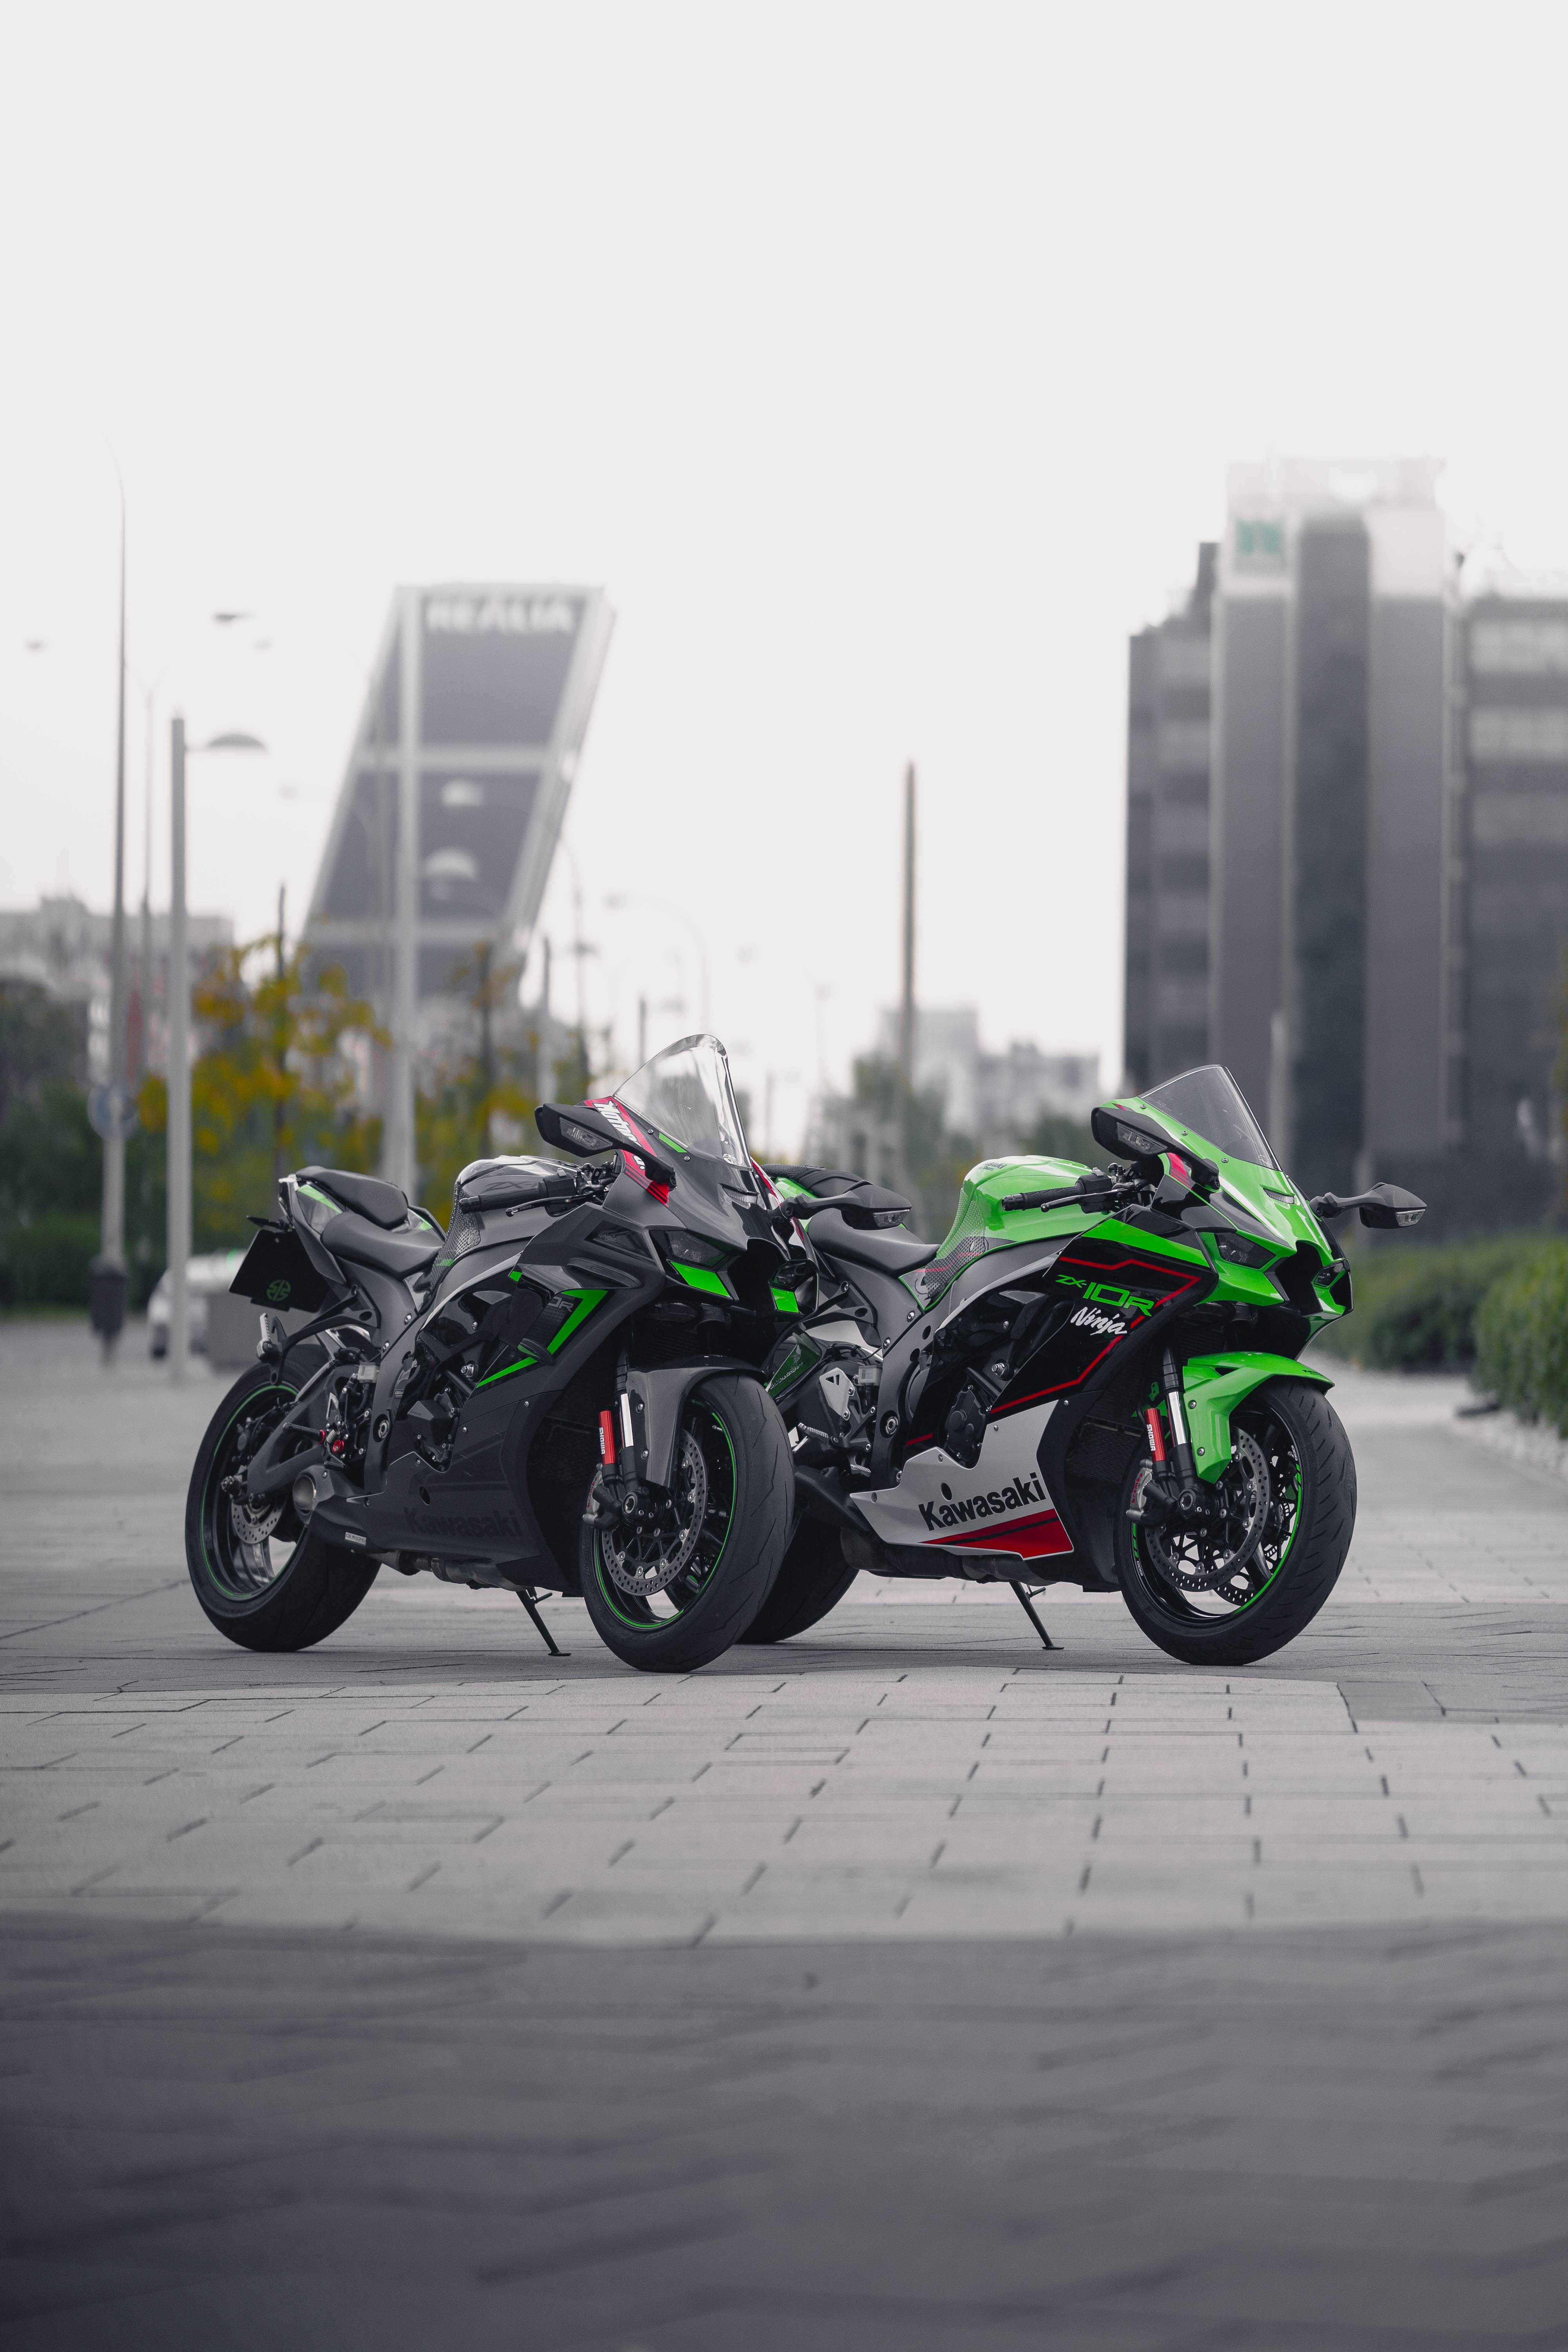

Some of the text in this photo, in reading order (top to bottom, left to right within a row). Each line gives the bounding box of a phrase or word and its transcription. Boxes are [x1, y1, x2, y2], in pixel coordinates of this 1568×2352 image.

[1055, 1274, 1154, 1316] ZX-10R
[1071, 1307, 1127, 1336] Ninja
[1147, 1424, 1156, 1451] SHOWA
[918, 1472, 1046, 1532] Kawasaki
[1131, 1474, 1142, 1503] brembo
[403, 1506, 523, 1537] Kawasaki
